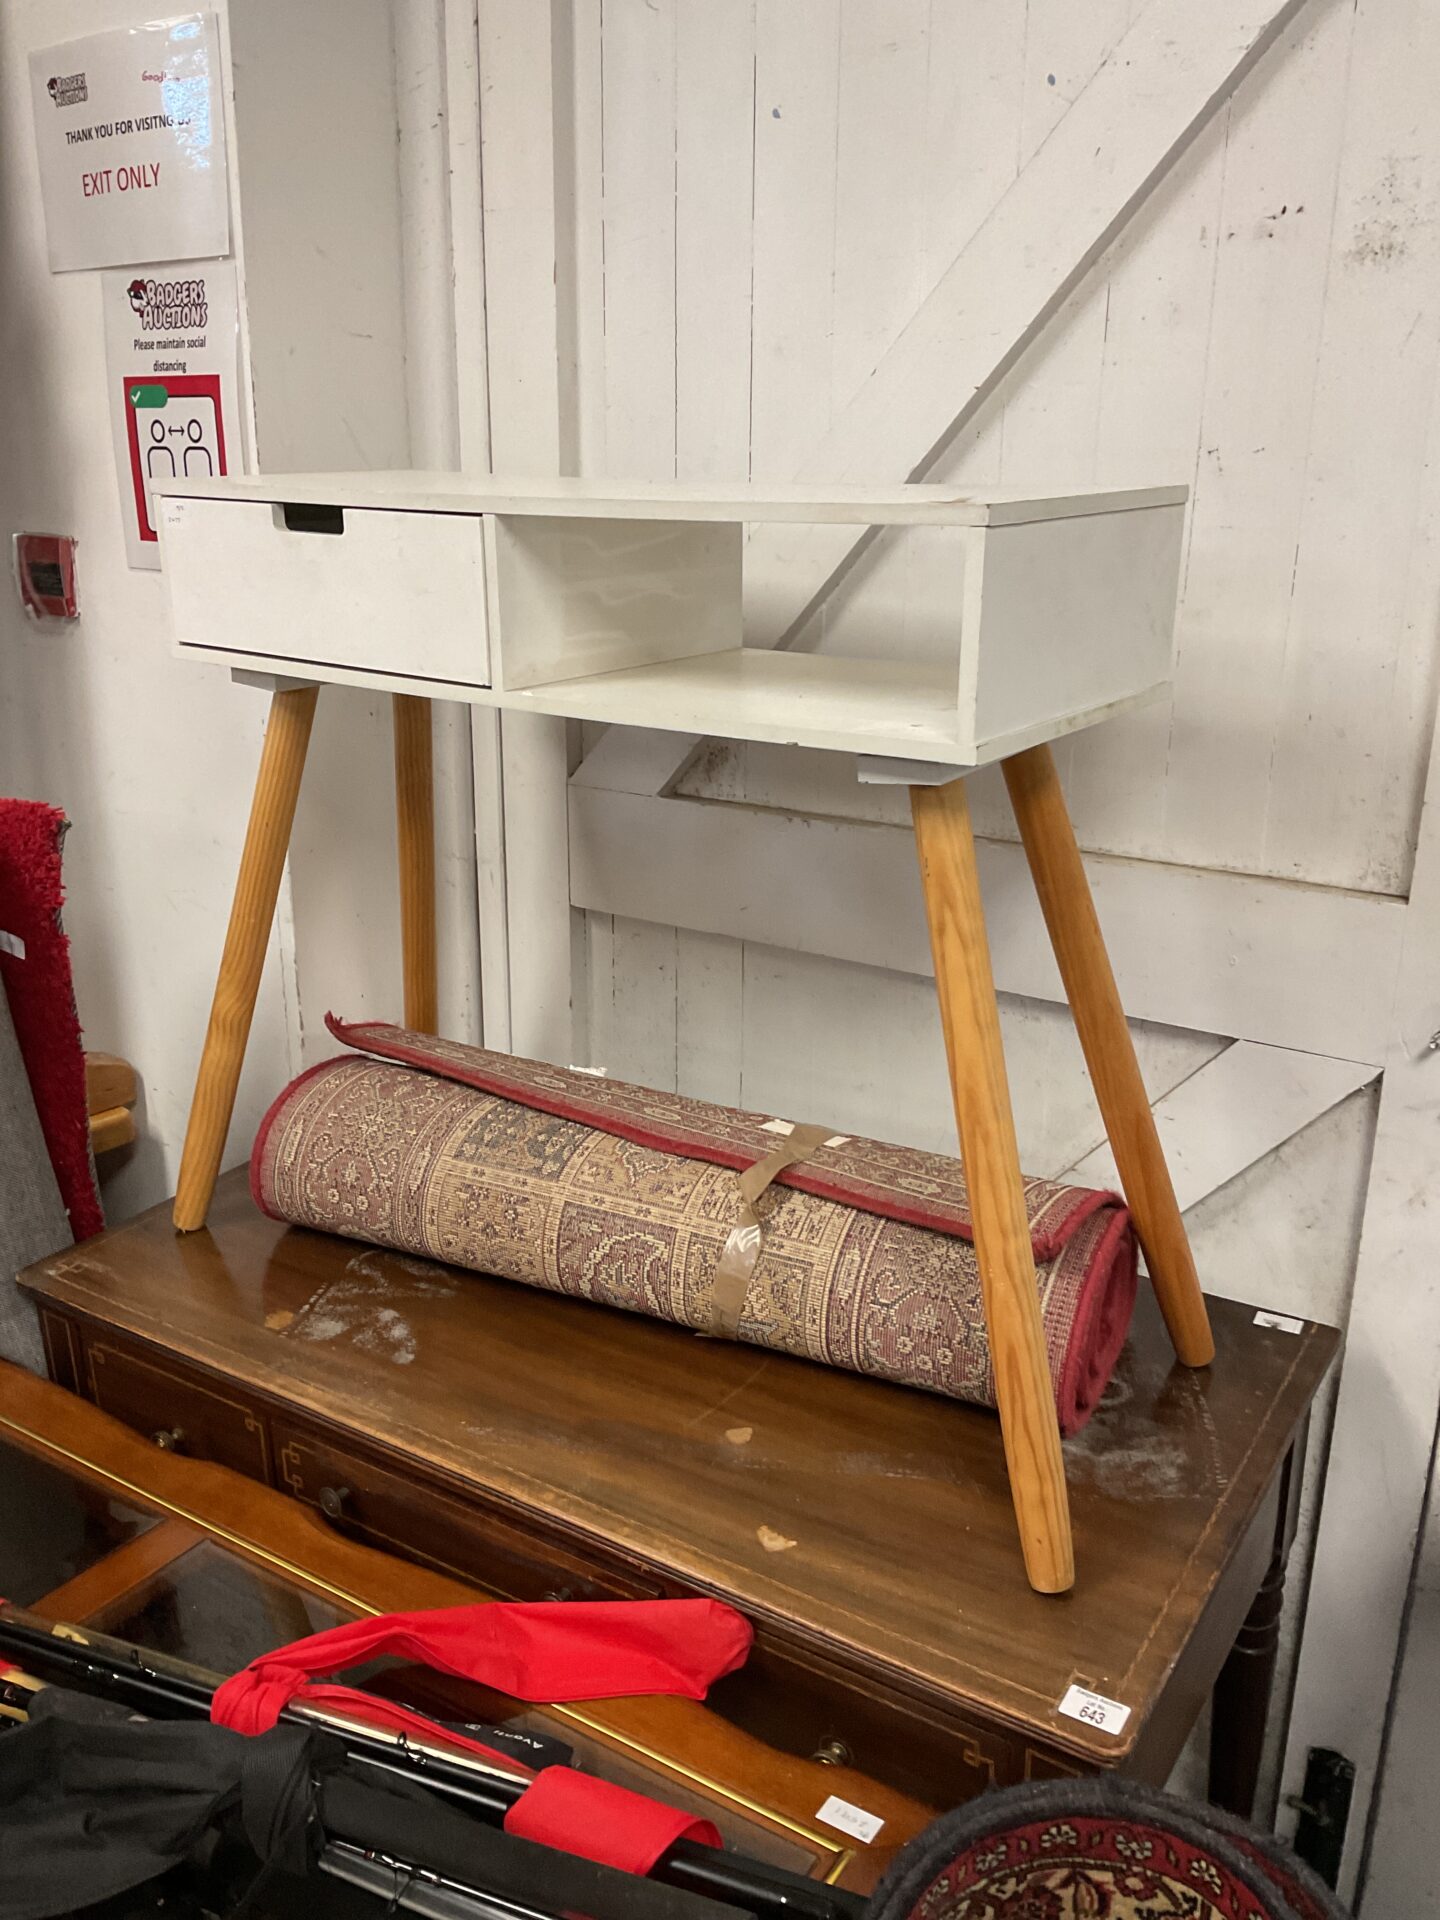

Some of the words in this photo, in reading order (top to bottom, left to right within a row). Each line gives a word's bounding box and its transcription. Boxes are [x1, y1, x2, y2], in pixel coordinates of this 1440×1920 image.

[65, 127, 94, 144] THANK
[94, 123, 113, 139] YOU
[115, 120, 134, 135] FOR
[134, 115, 174, 132] VISITNG
[82, 170, 112, 197] EXIT
[116, 162, 160, 191] ONLY
[145, 279, 205, 307] BADGERS
[142, 302, 208, 330] AUCTIONS
[133, 338, 155, 350] Please
[156, 337, 186, 349] maintain
[186, 336, 206, 348] social
[153, 359, 187, 373] distancing
[1079, 1705, 1106, 1725] 643
